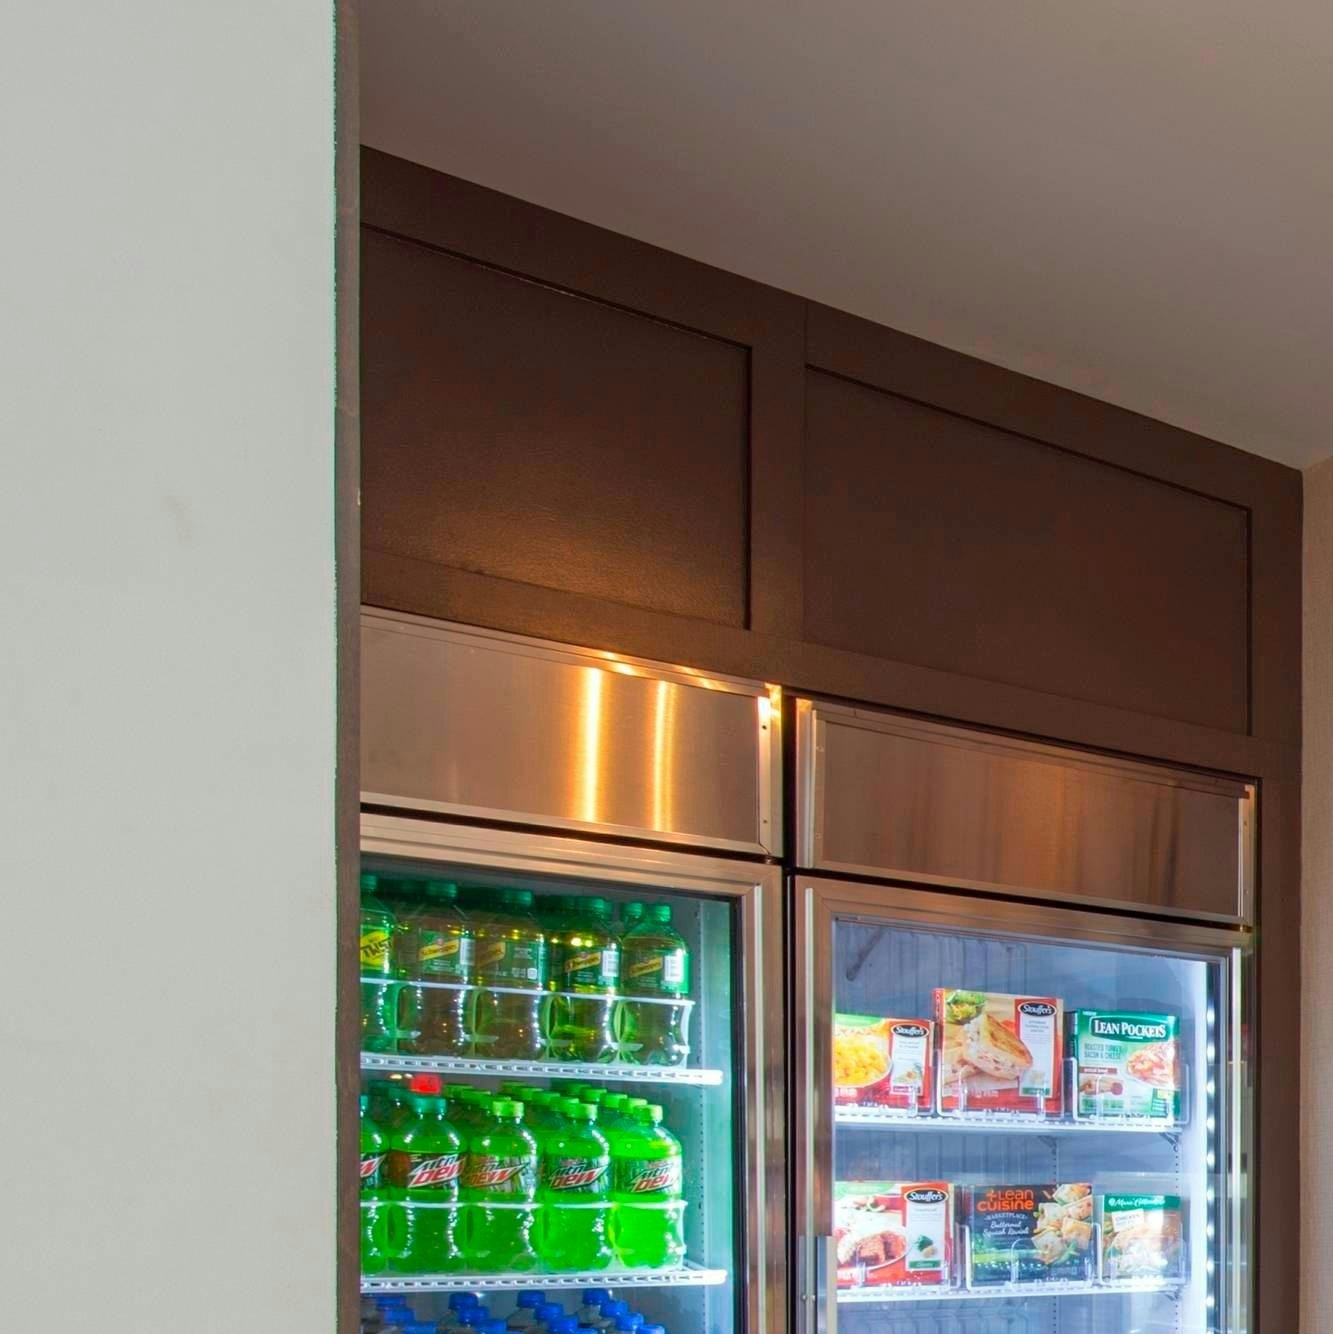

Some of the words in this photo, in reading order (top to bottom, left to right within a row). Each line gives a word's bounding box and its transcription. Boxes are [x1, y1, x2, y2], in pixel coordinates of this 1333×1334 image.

[1094, 1018, 1121, 1033] LEAN
[1122, 1021, 1167, 1038] POCKETS
[908, 1191, 943, 1202] Stouffer's
[976, 1199, 1034, 1212] cuisine
